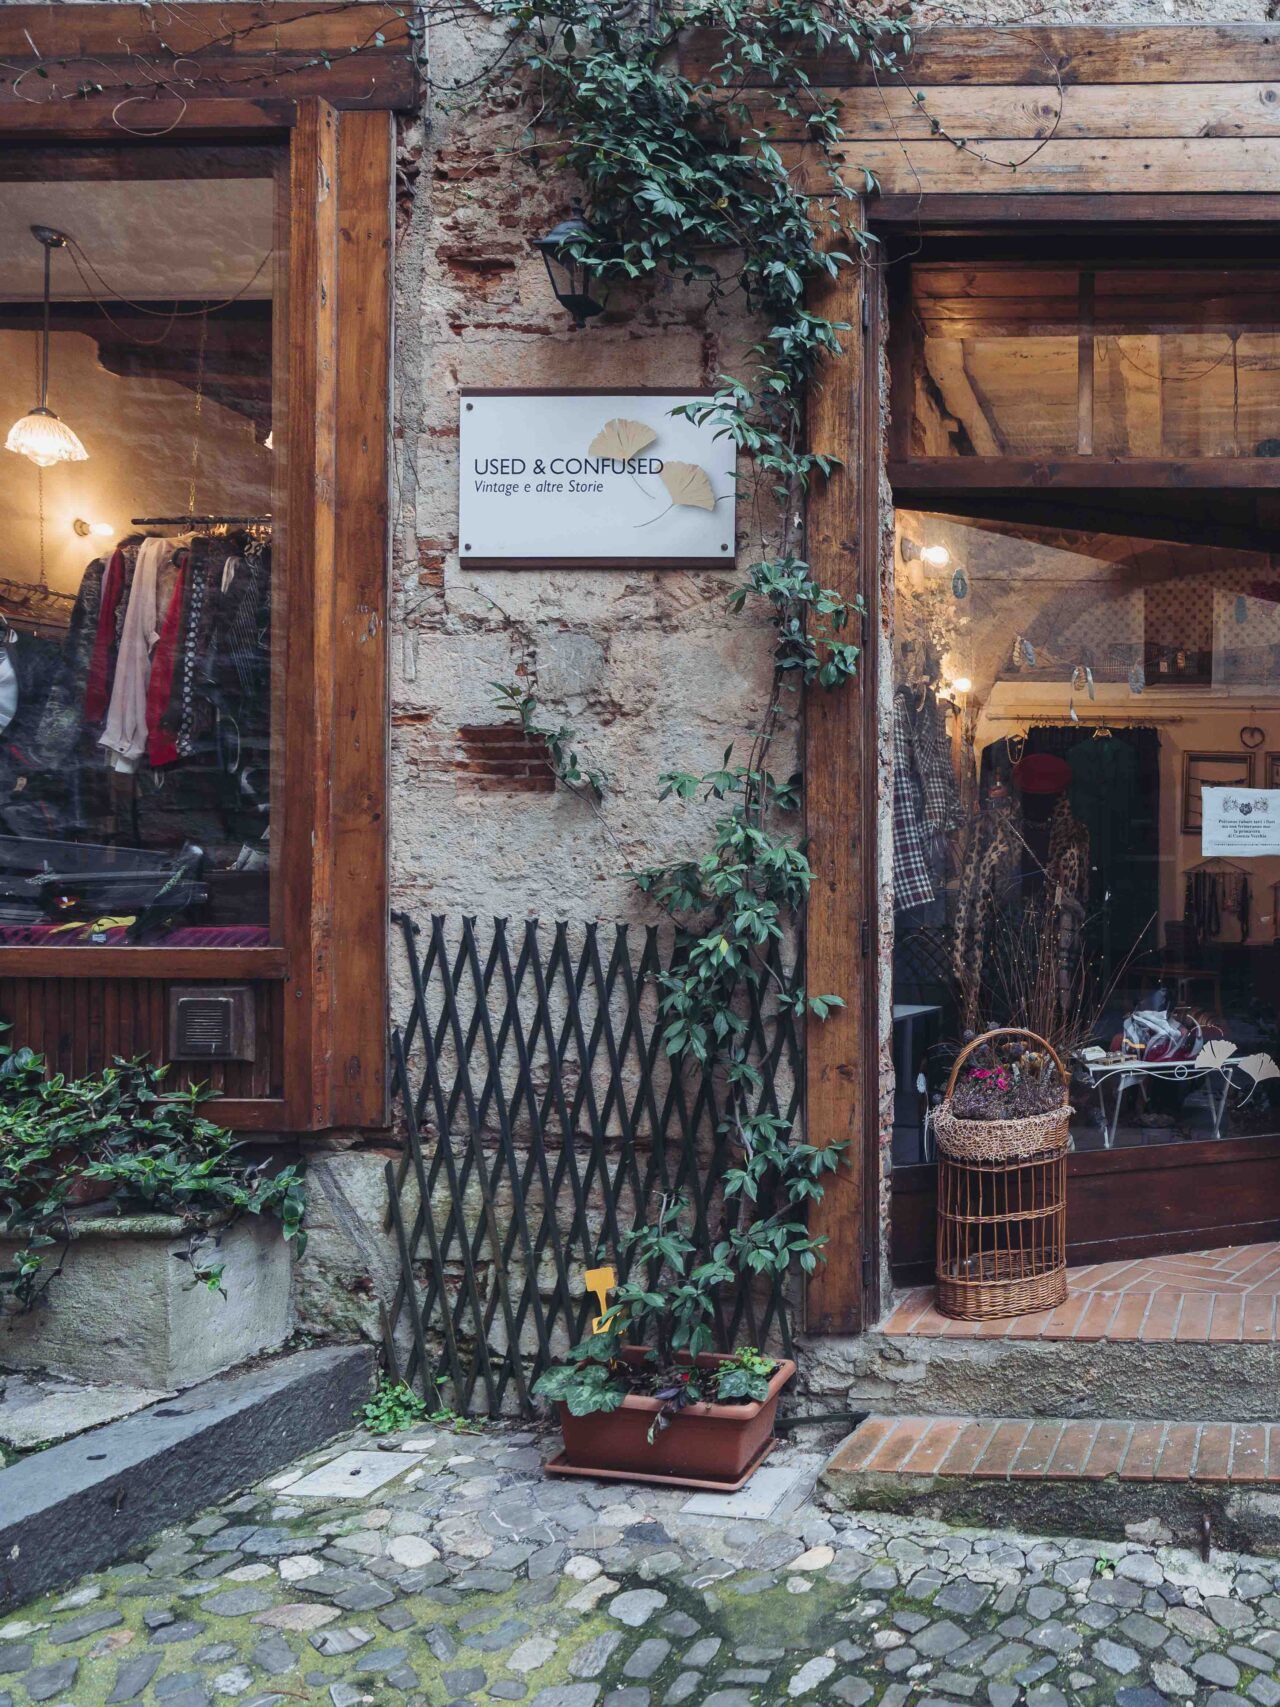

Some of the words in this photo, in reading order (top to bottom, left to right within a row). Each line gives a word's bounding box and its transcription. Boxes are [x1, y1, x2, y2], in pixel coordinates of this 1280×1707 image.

[474, 458, 526, 475] USED
[532, 458, 546, 475] &
[550, 458, 664, 475] CONFUSED
[474, 480, 520, 496] Vintage
[524, 483, 531, 493] e
[535, 480, 564, 493] altre
[568, 480, 604, 493] Storie
